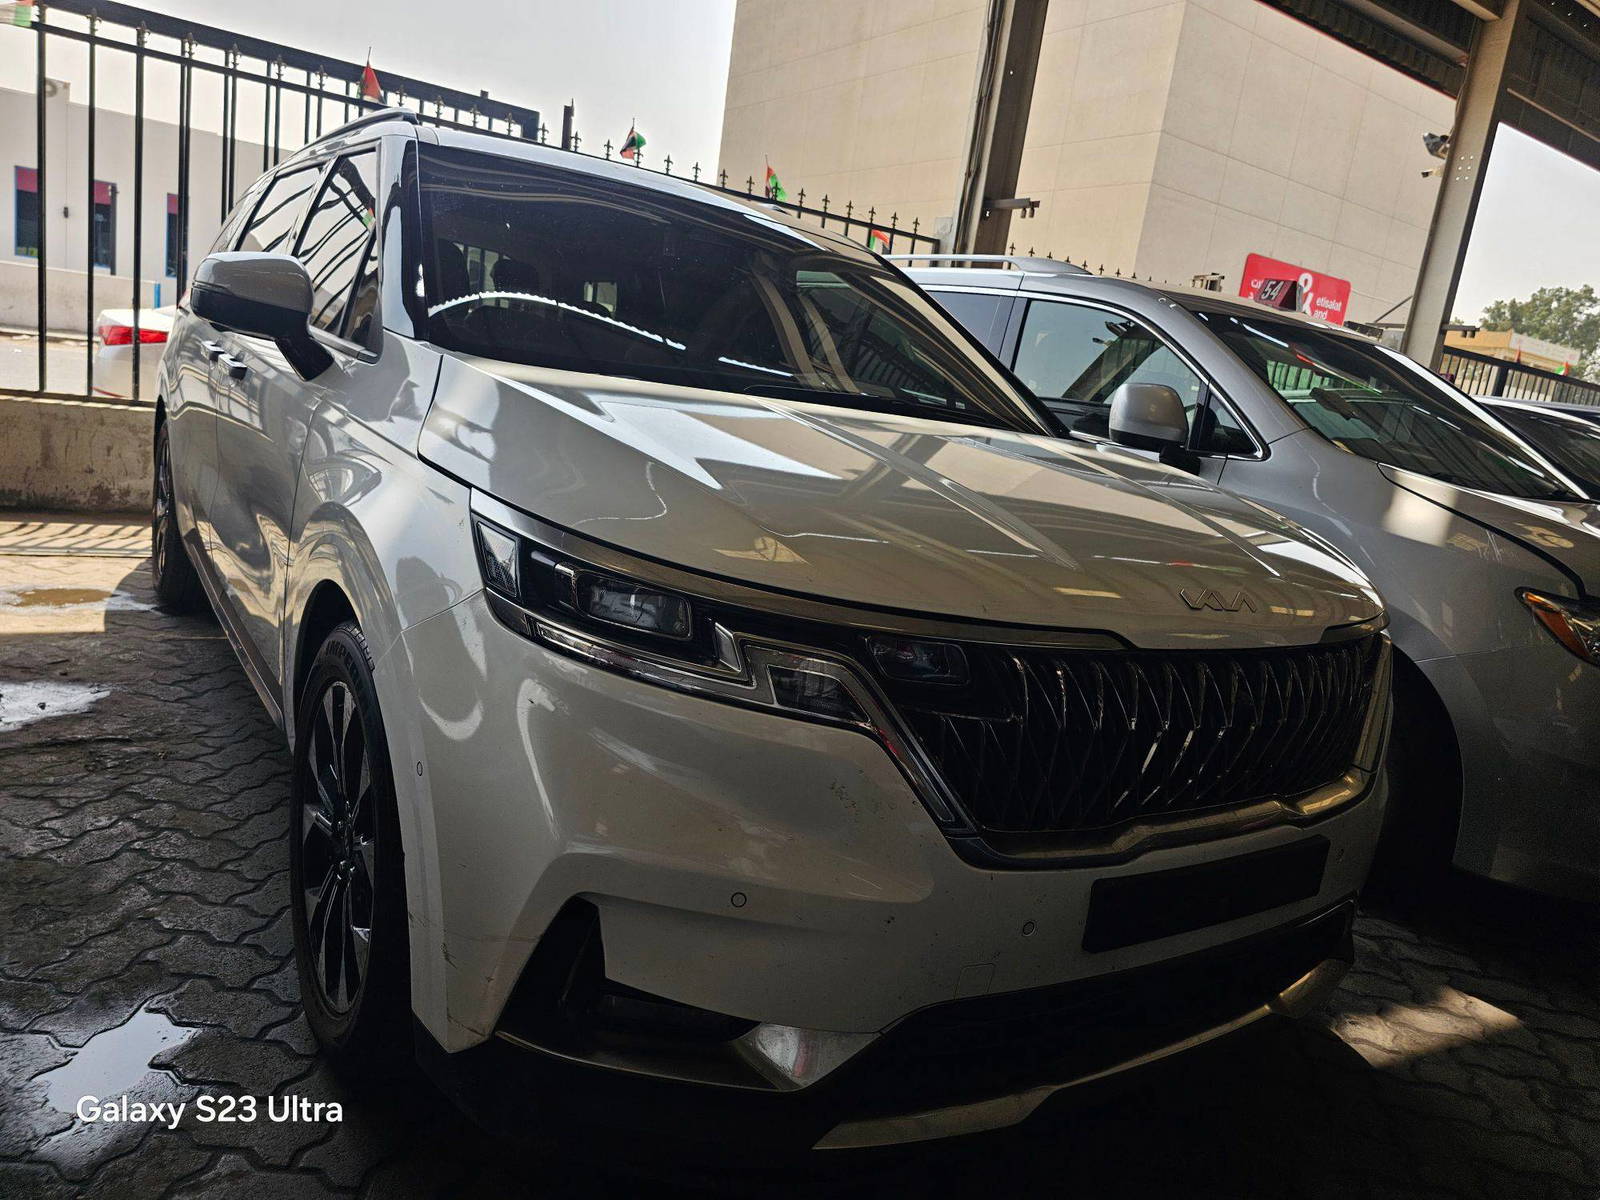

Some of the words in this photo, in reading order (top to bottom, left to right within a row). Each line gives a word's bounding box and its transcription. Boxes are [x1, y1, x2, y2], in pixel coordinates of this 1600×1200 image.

[1261, 280, 1284, 300] 54
[1316, 297, 1342, 311] etisalat
[1313, 310, 1328, 320] and
